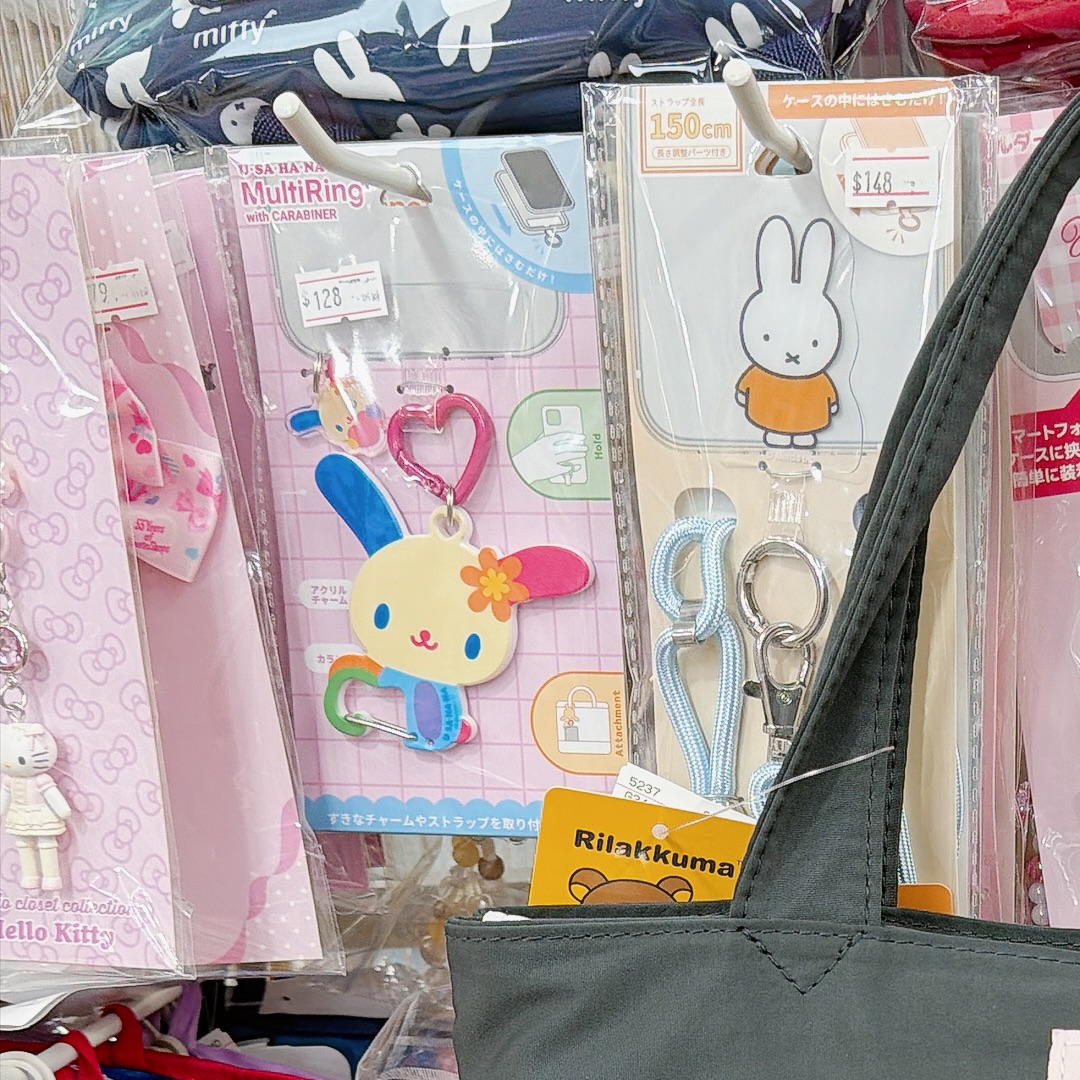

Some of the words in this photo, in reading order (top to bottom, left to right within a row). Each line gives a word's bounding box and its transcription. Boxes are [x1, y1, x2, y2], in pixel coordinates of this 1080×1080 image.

[193, 16, 270, 49] miffy
[650, 111, 732, 140] 150cm
[657, 148, 726, 158] 長さ調整パーツ付き
[852, 170, 893, 194] $148
[246, 211, 270, 223] with
[272, 209, 338, 222] CARABINER
[302, 287, 343, 312] $128
[592, 433, 603, 460] Hold
[311, 585, 348, 595] アクリル
[311, 596, 348, 605] チャーム
[613, 690, 624, 757] Attachment
[628, 776, 661, 797] 5237
[574, 829, 735, 878] Rilakkuma
[54, 922, 114, 950] Kitty
